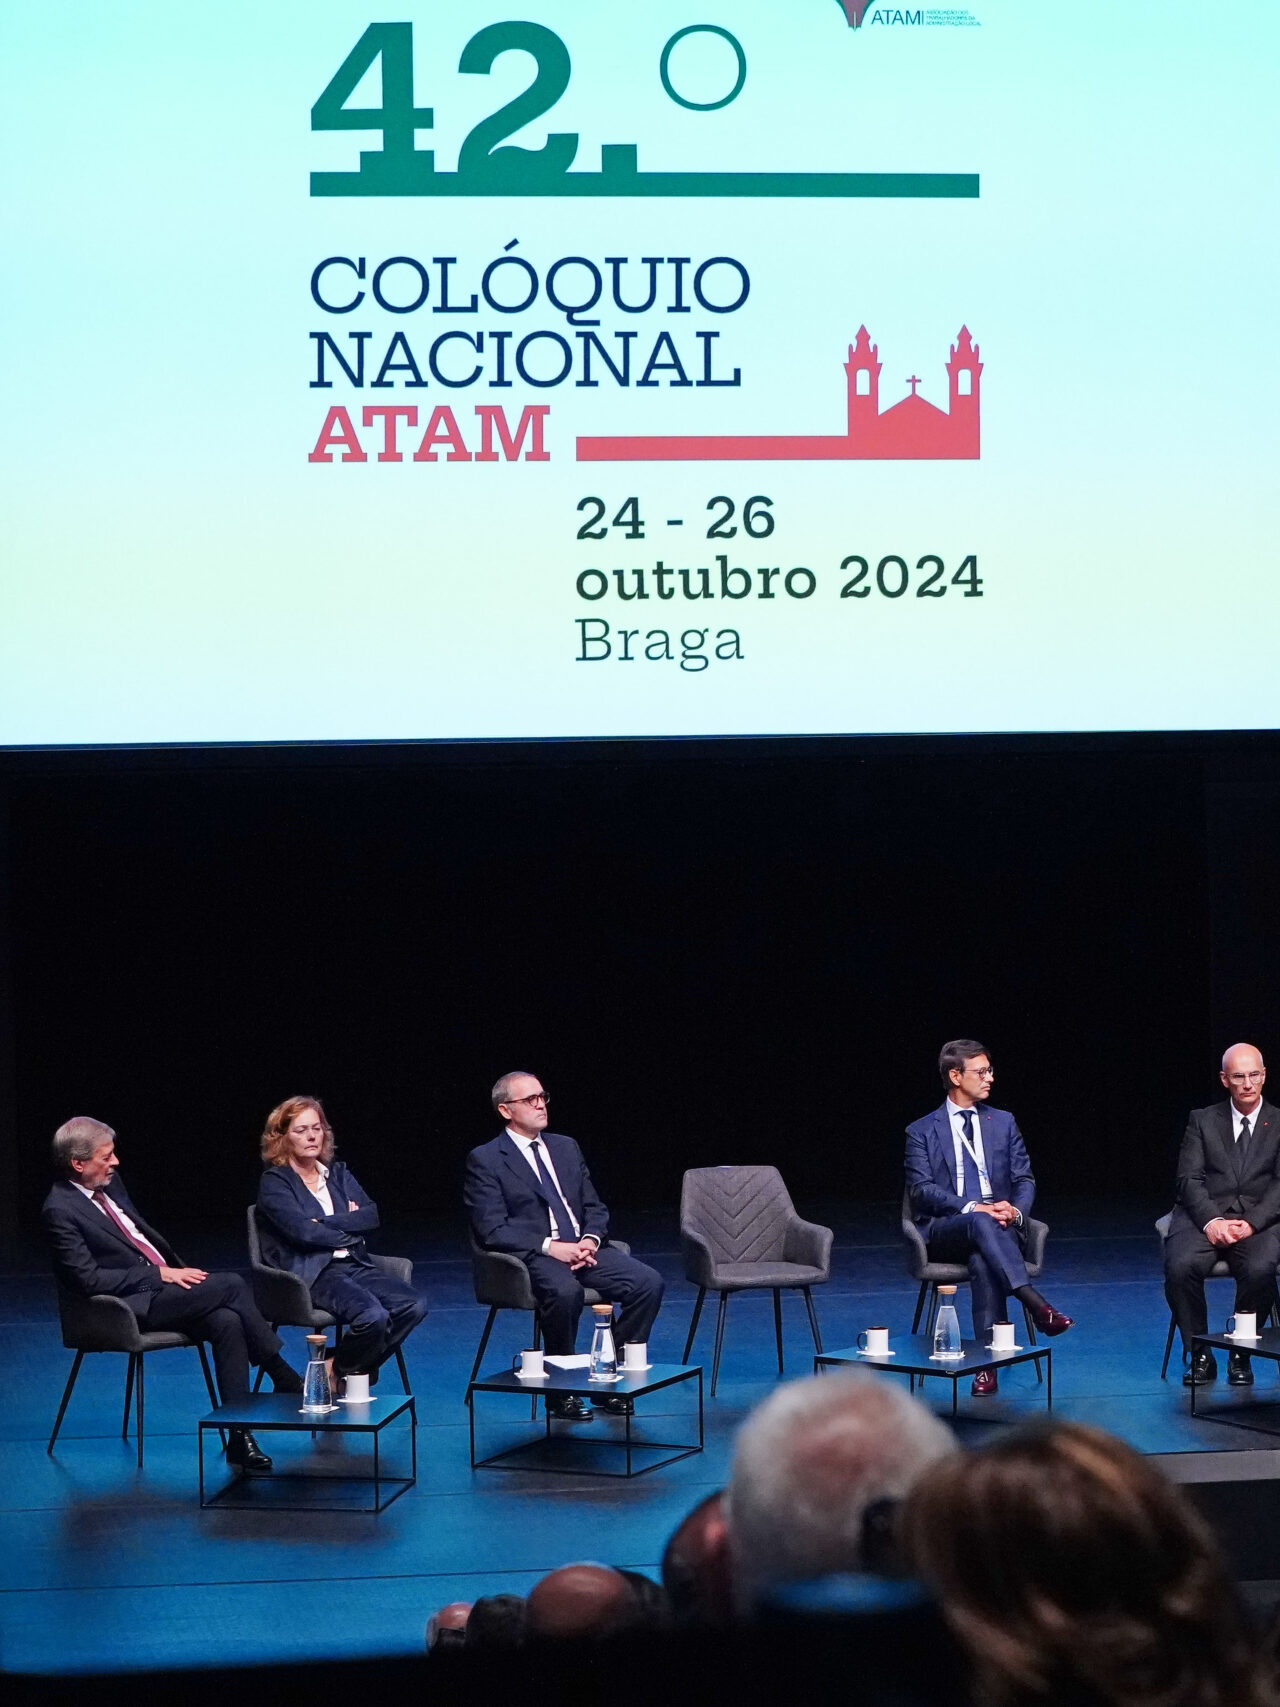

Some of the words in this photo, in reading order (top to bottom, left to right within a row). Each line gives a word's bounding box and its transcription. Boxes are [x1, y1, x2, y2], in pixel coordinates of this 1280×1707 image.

[871, 10, 921, 25] ATAM
[310, 238, 751, 326] COLÓQUIO
[309, 330, 742, 388] NACIONAL
[308, 405, 551, 463] ATAM
[575, 496, 646, 540] 24
[705, 495, 776, 540] 26
[575, 555, 818, 601] outubro
[838, 555, 984, 599] 2024
[575, 617, 745, 672] Braga
